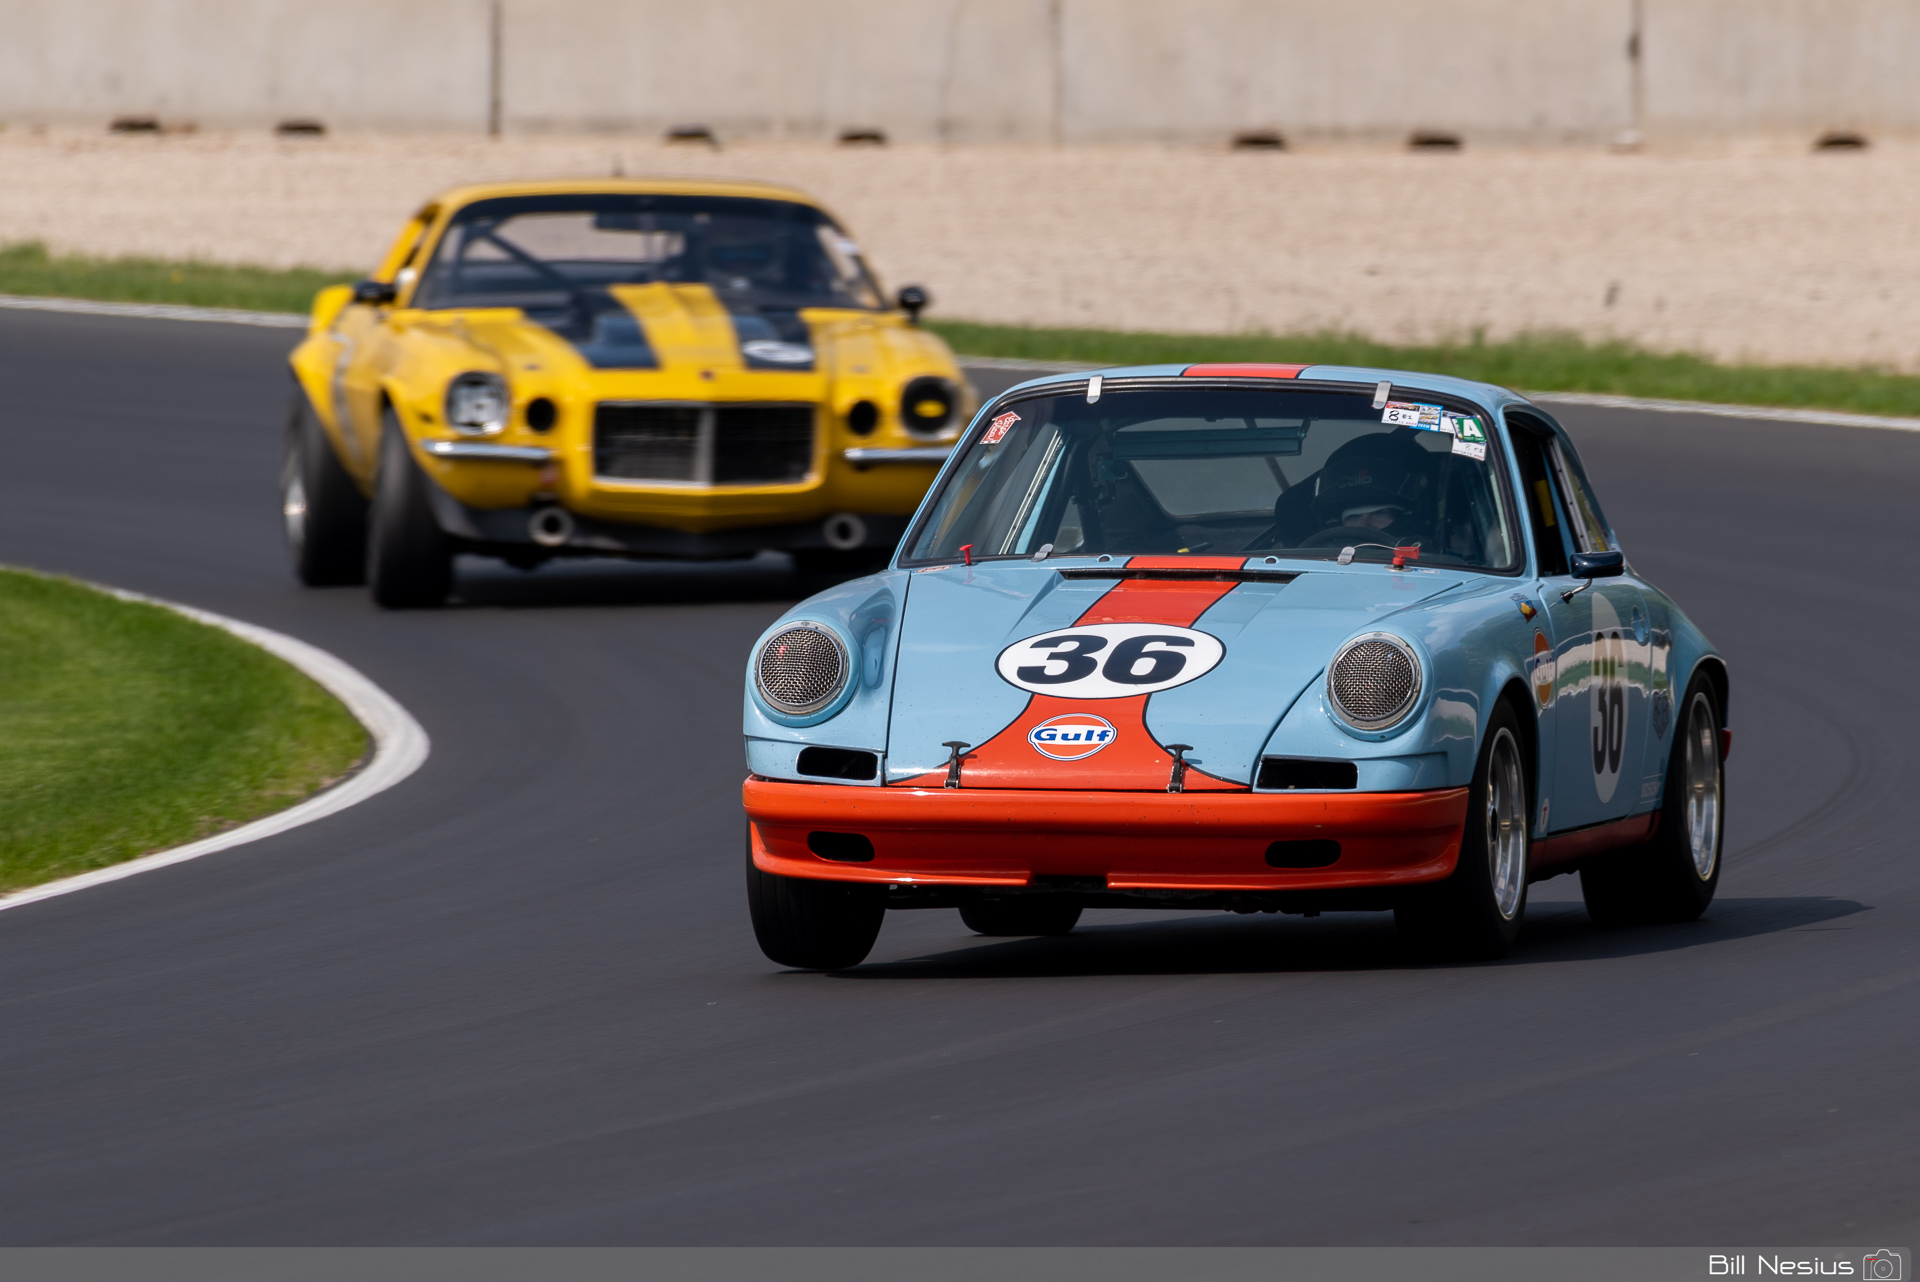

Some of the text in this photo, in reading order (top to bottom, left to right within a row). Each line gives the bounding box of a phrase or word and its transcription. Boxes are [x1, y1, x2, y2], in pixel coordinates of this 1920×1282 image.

[1463, 418, 1483, 438] A
[1016, 634, 1196, 685] 36
[1592, 631, 1625, 775] 36
[1033, 727, 1112, 743] Gulf
